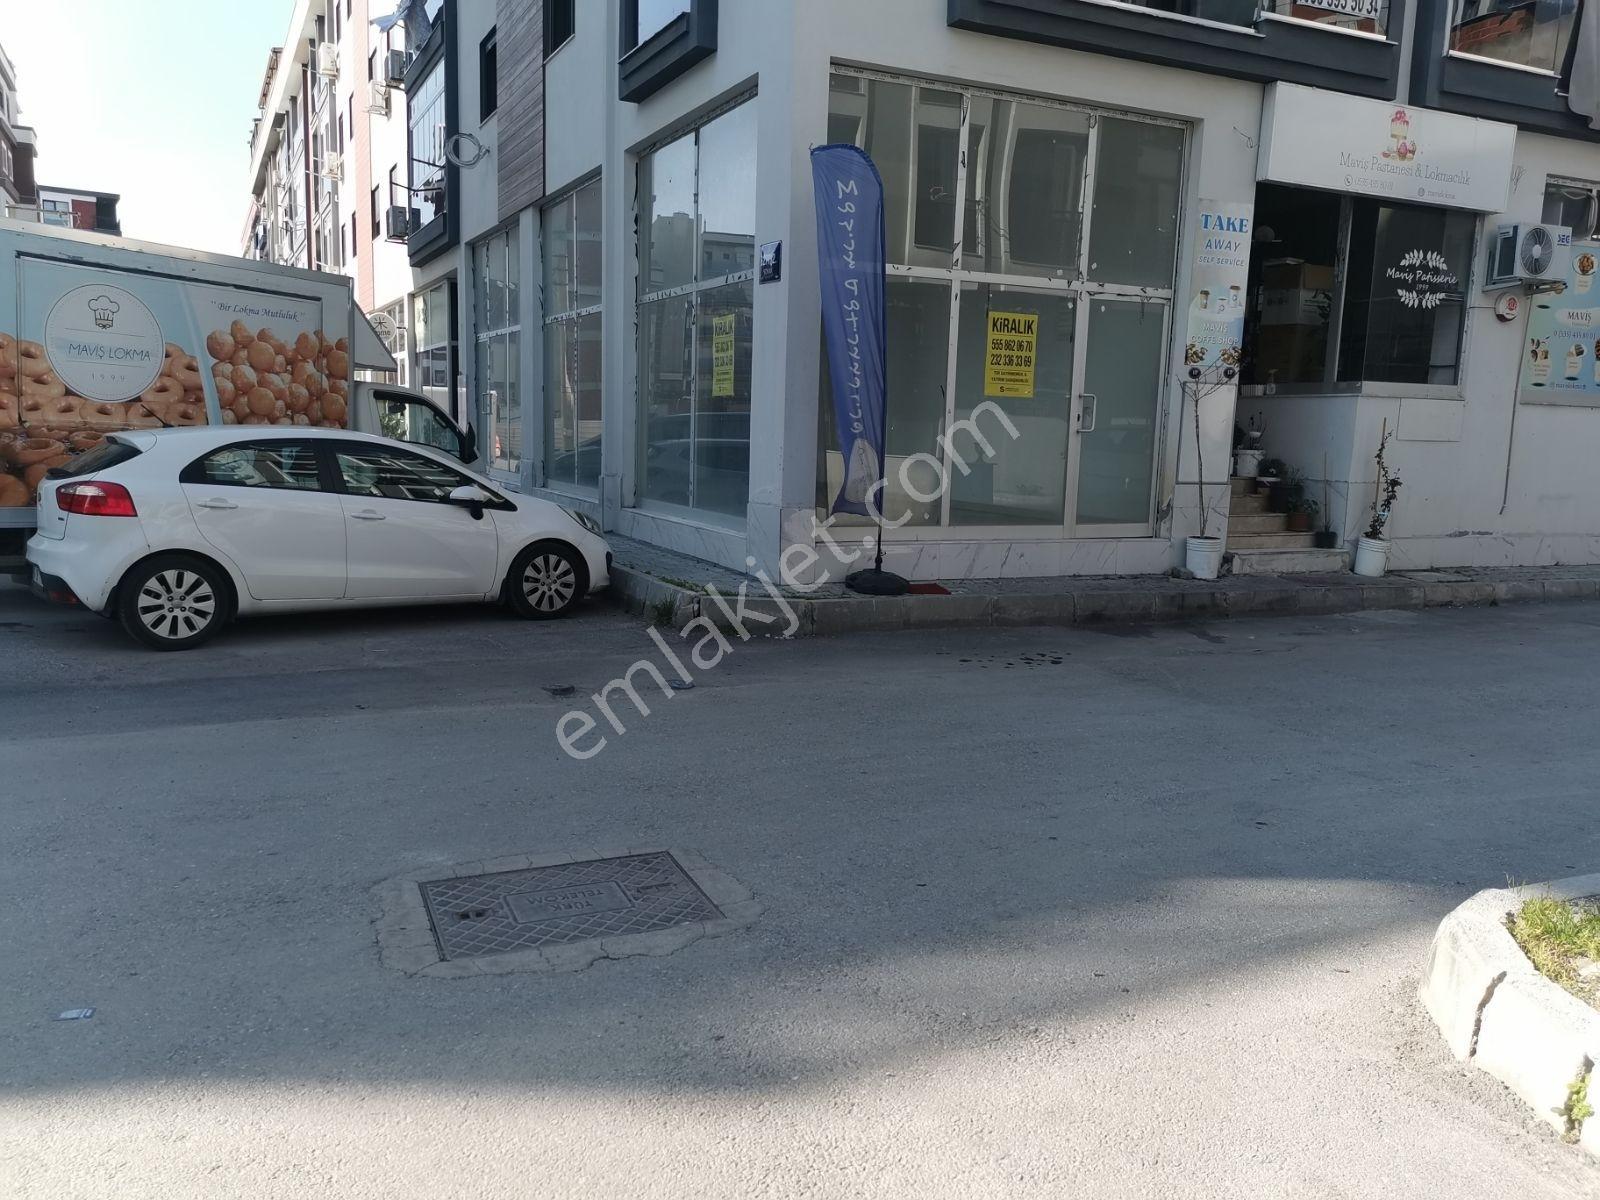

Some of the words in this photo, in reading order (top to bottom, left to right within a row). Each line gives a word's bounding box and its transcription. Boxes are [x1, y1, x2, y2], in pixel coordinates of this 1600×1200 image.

[1415, 163, 1422, 177] &
[1201, 213, 1249, 233] TAKE
[1205, 239, 1240, 252] AWAY
[1216, 257, 1245, 267] SERVICE
[1416, 270, 1458, 284] Patisserie
[233, 304, 260, 316] Lokma
[991, 339, 1003, 351] 555
[1025, 341, 1033, 353] 70
[1217, 336, 1239, 346] SHOP
[109, 347, 150, 361] LOKMA
[990, 354, 1002, 366] 232
[526, 888, 605, 905] TELEKOM
